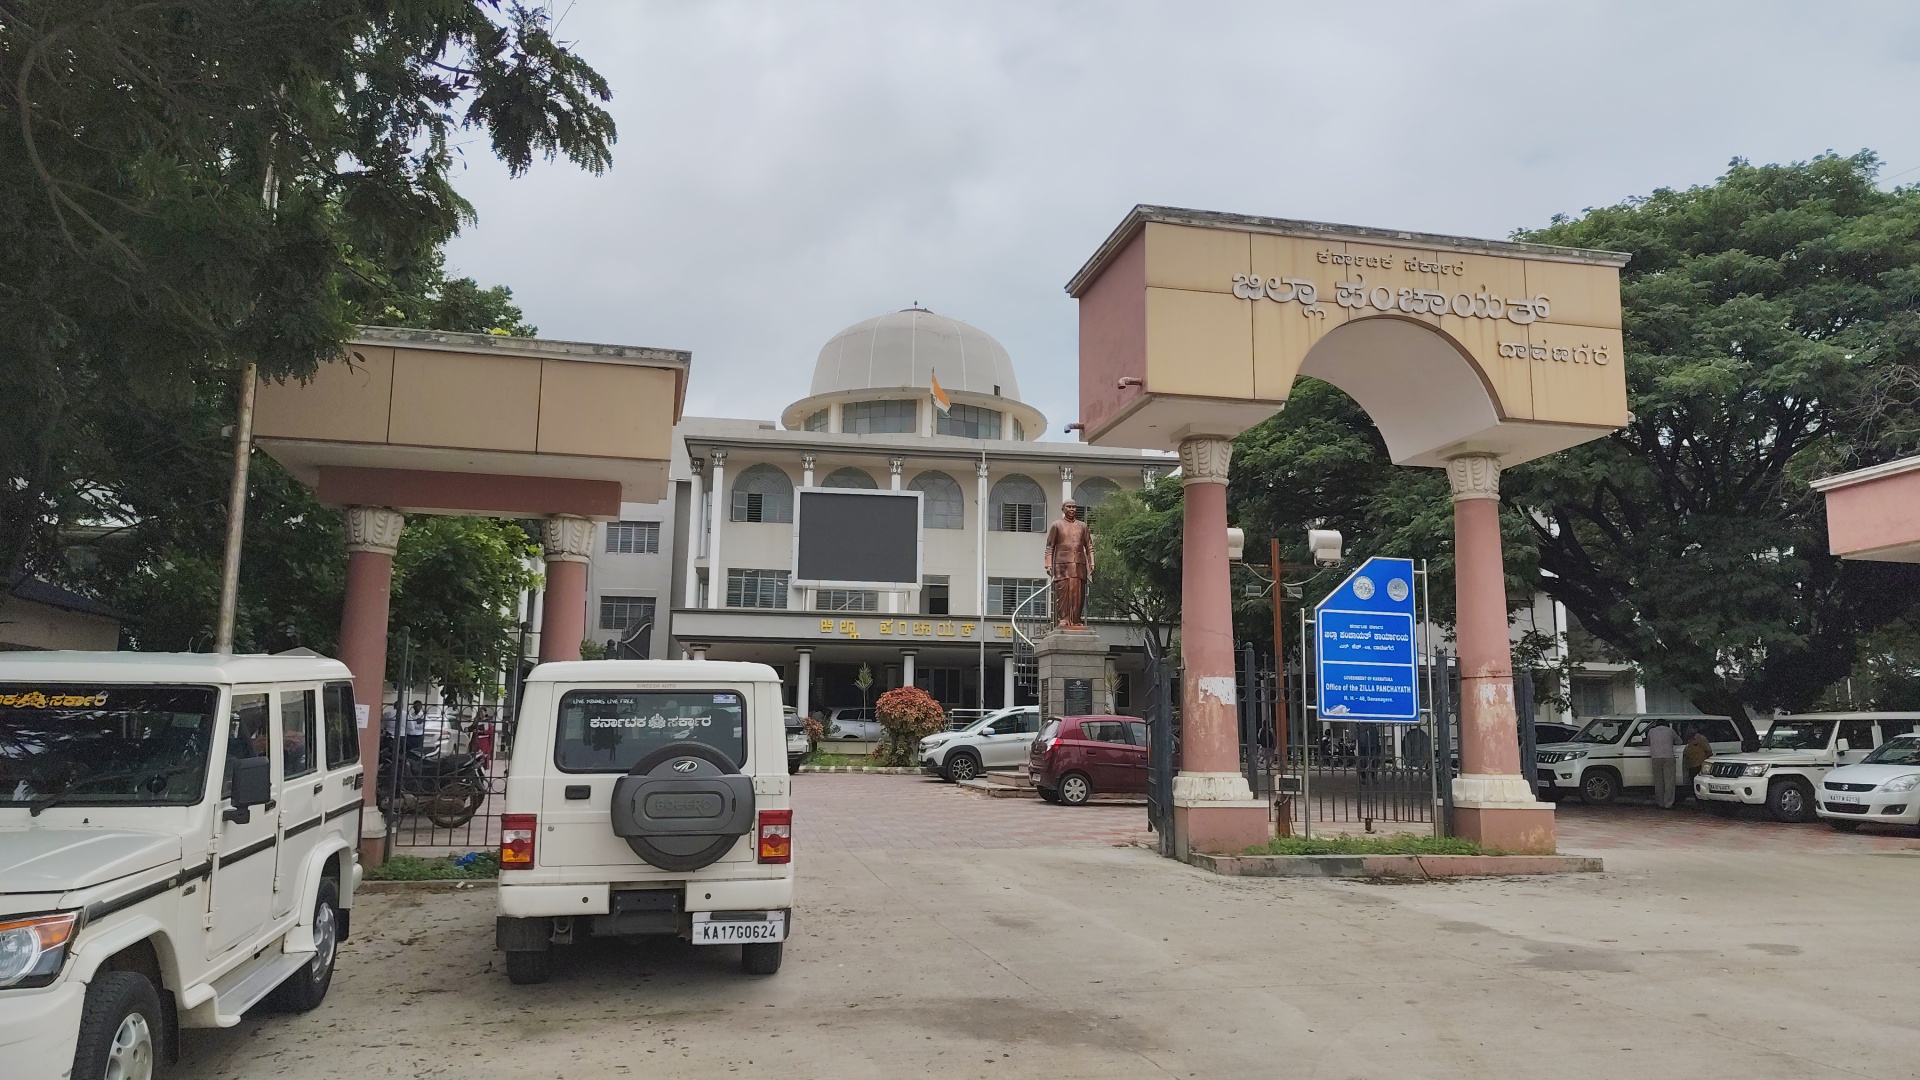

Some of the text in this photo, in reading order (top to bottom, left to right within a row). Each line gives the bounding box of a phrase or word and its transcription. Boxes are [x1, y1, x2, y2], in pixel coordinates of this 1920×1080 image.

[1317, 249, 1464, 276] ಕರ್ನಾಟಕ ಸರ್ಕಾರ
[1232, 273, 1550, 325] ಜಿಲ್ಲಾ ಪಂಚಾಯತ್
[1497, 340, 1610, 365] ದಾವಣಗೆರೆ
[820, 619, 860, 639] ಜಿಲ್ಲಾ
[880, 618, 976, 637] ಪಂಚಾಯತ್
[1326, 683, 1342, 691] Office
[1343, 683, 1348, 691] of
[1360, 684, 1375, 692] ZILLA
[1376, 685, 1411, 693] PANCHAYATH
[590, 715, 712, 728] ಕರ್ನಾಟಕ ಸರ್ಕಾರ
[655, 799, 712, 812] BOLERO
[703, 925, 776, 940] KA17G0624
